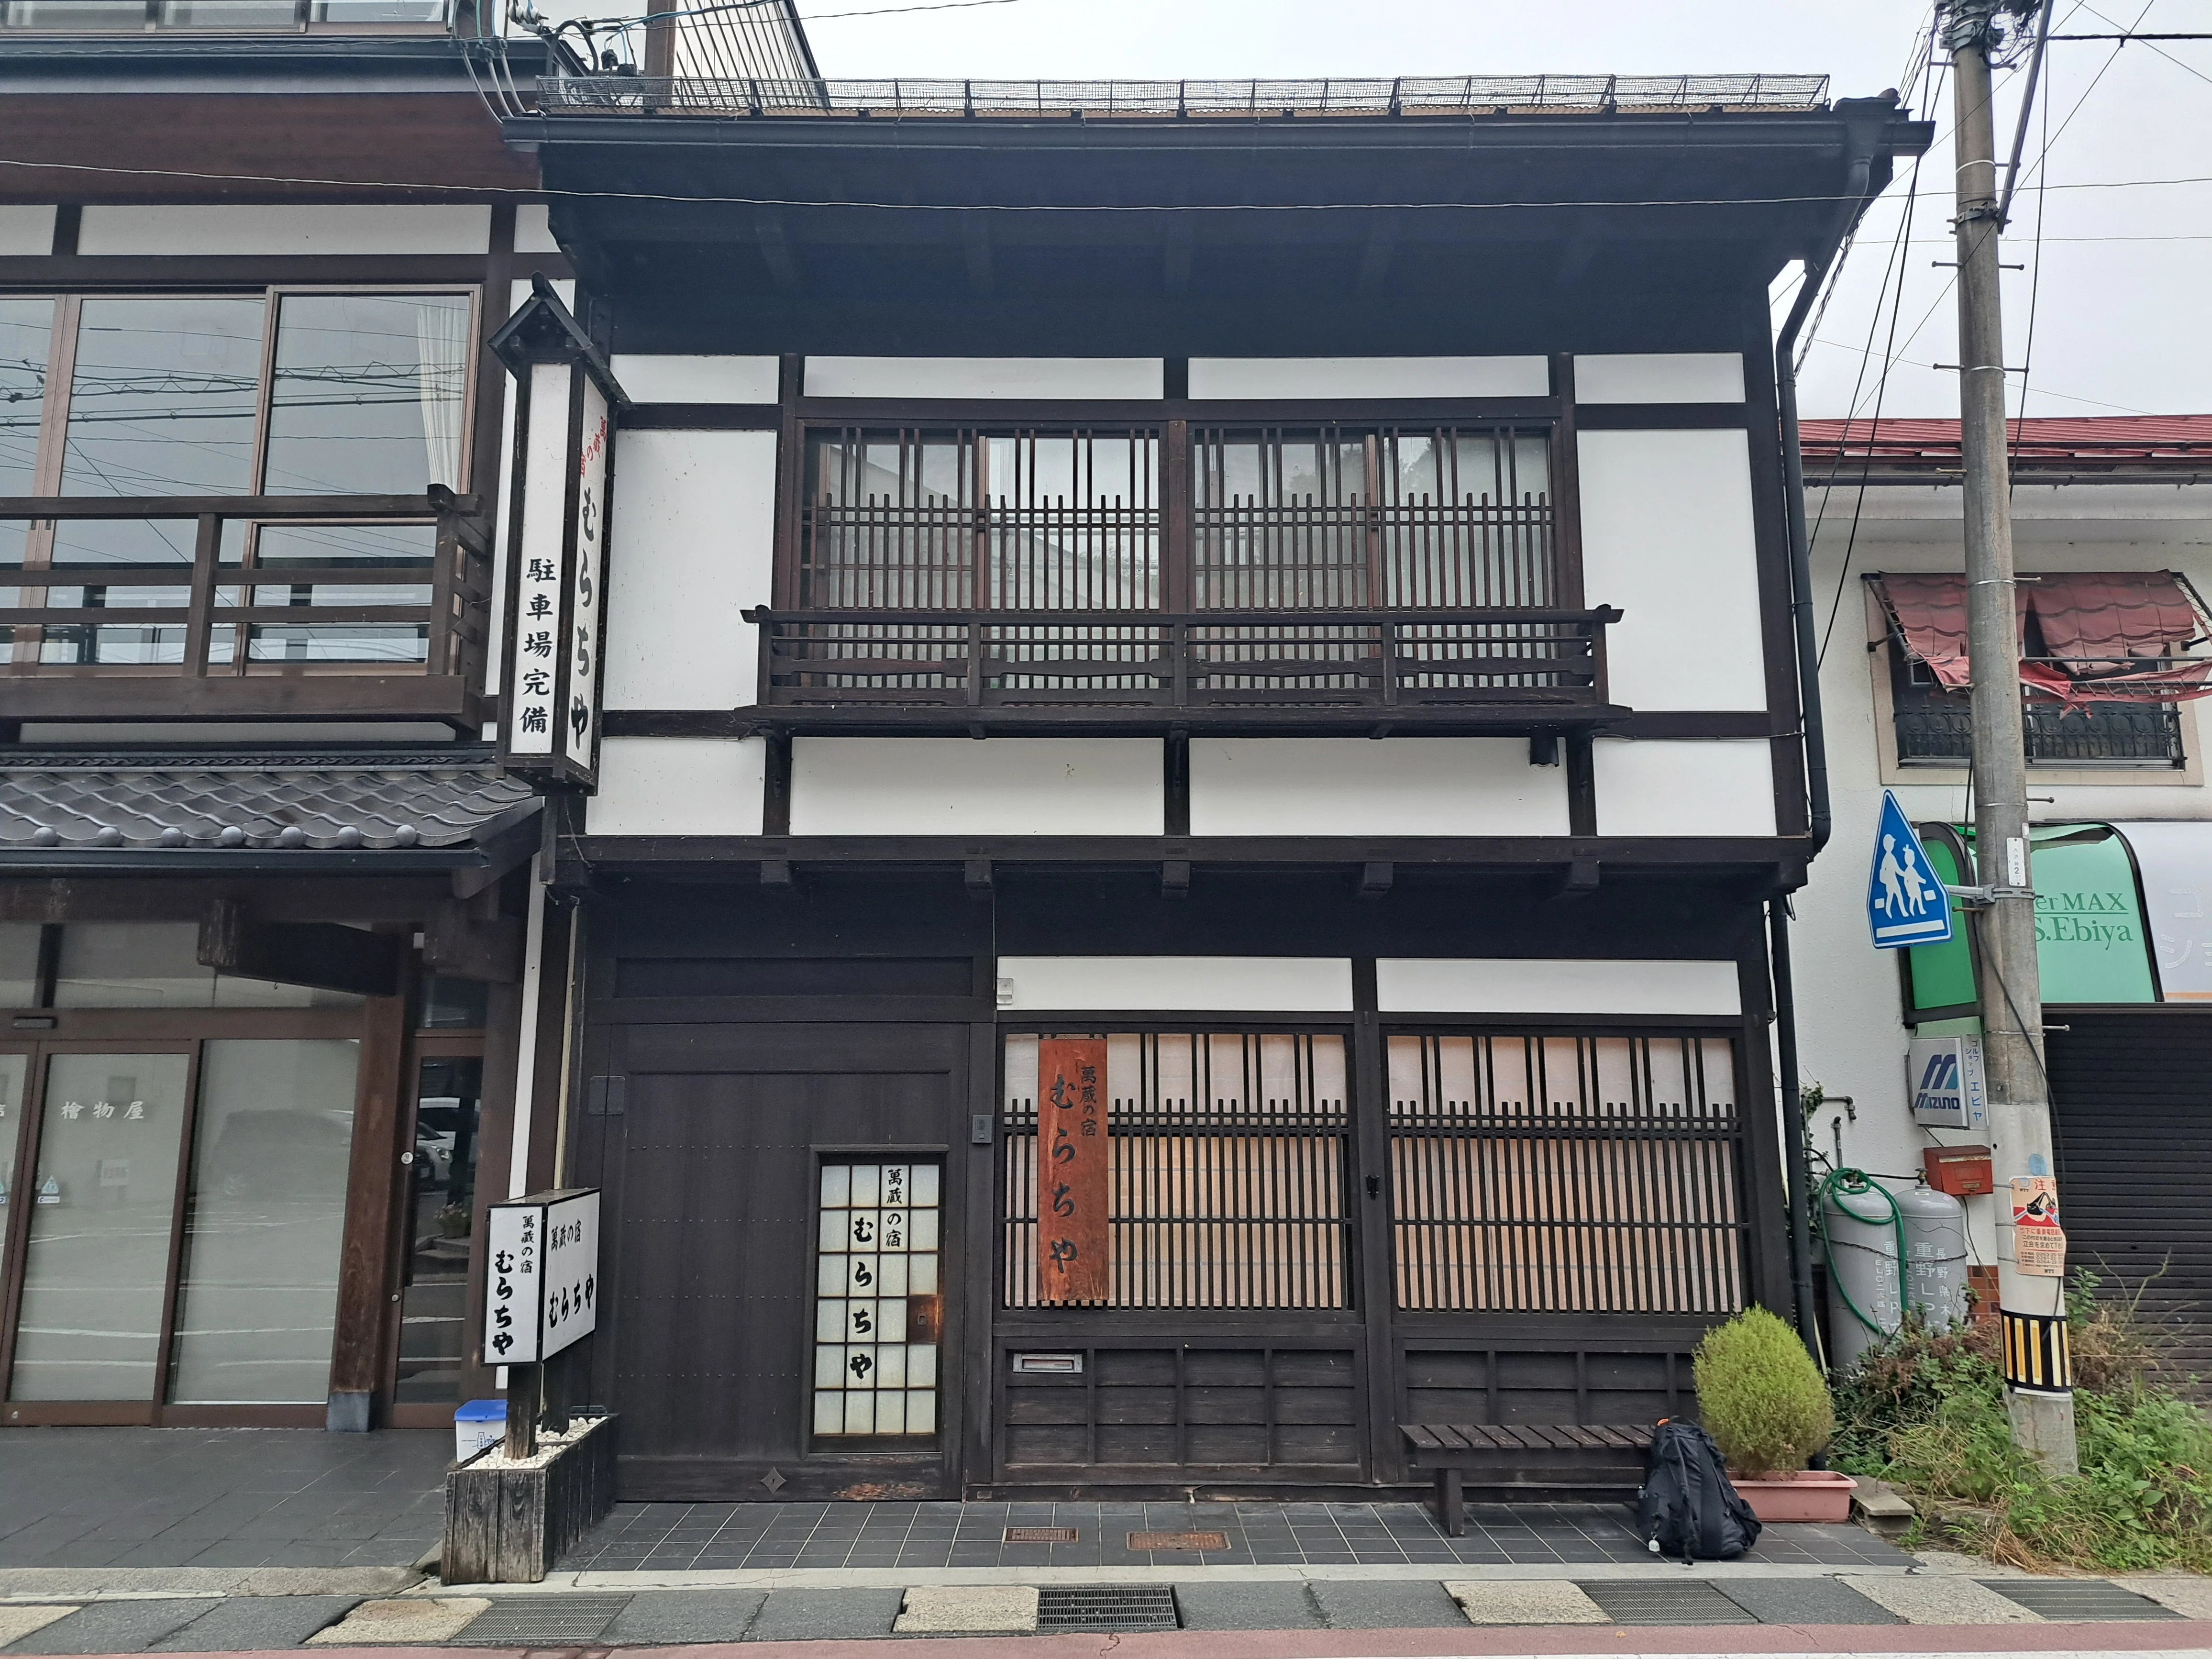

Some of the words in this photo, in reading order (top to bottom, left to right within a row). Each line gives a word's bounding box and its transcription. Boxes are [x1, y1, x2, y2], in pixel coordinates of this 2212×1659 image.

[519, 557, 556, 734] 駐車場完備
[571, 488, 598, 750] むらちや
[2035, 897, 2058, 910] er
[2060, 893, 2128, 910] MAX
[61, 1101, 144, 1120] 檜物屋
[1080, 1066, 1097, 1137] 萬蔵の宿
[1970, 1082, 1982, 1121] エビヤ
[886, 1169, 903, 1248] 萬蔵の宿
[1050, 1074, 1079, 1273] むらちや
[520, 1215, 535, 1274] 萬蔵の宿
[492, 1250, 514, 1356] むらちや
[549, 1273, 594, 1328] むらちや
[850, 1217, 874, 1379] むらちや
[1936, 1248, 1952, 1330] 長野県木
